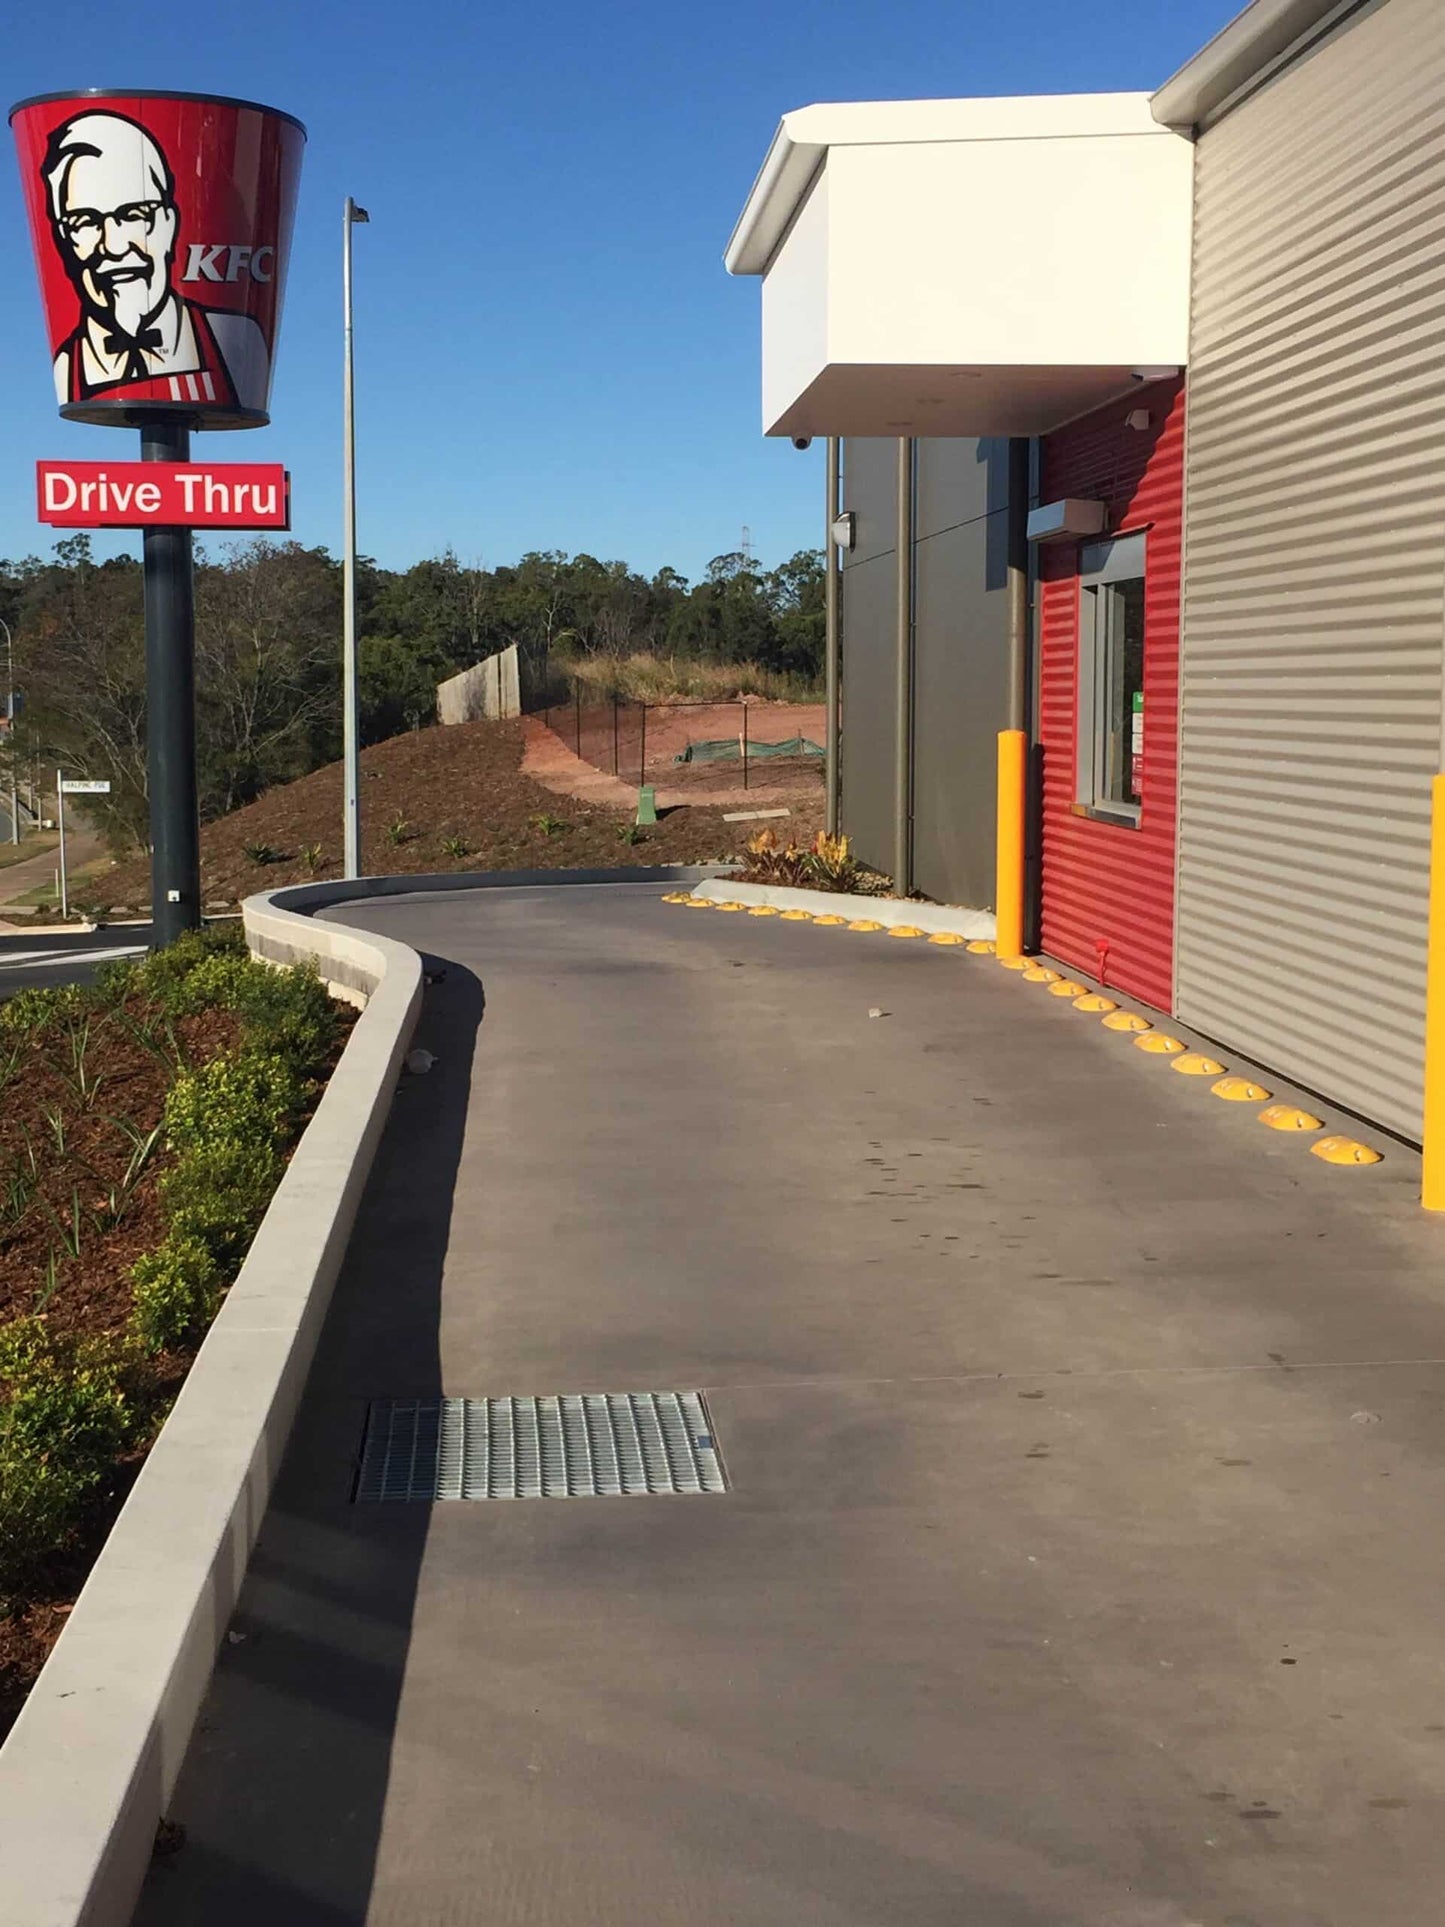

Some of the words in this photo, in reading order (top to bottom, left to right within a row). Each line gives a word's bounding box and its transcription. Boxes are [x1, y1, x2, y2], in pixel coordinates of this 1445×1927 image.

[182, 244, 274, 282] KFC
[44, 472, 161, 512] Drive
[174, 474, 277, 514] Thru
